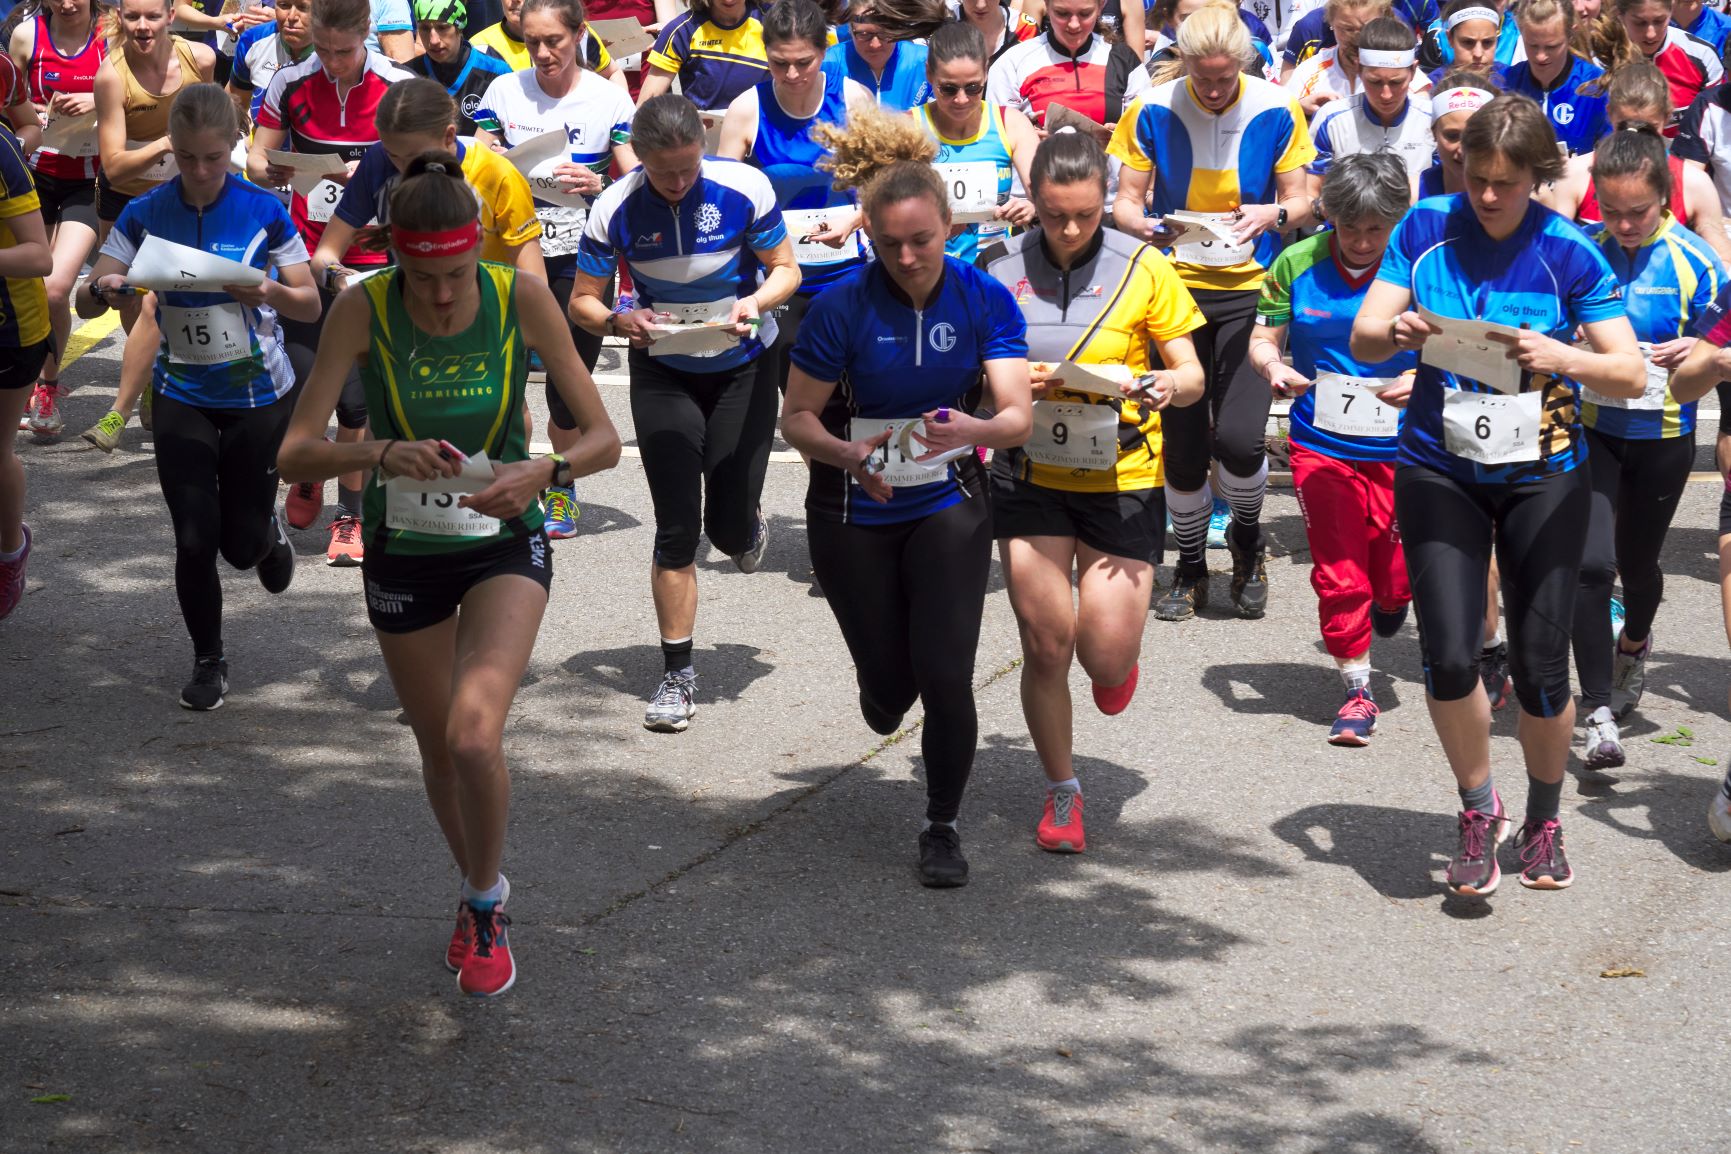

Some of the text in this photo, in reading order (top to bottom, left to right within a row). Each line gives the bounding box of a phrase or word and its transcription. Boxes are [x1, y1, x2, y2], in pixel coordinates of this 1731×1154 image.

[517, 125, 545, 133] TRIMTEX
[349, 147, 362, 157] olc
[696, 233, 725, 244] olg thun
[1502, 304, 1548, 317] olg thun
[182, 324, 229, 346] 15 1
[410, 386, 493, 399] ZIMMERBERG
[1341, 393, 1381, 417] 7 1
[1474, 414, 1521, 440] 6 1
[1052, 422, 1097, 447] 9 1
[880, 470, 943, 482] ZIMMERBERG
[391, 514, 494, 532] BANK ZIMMERBERG
